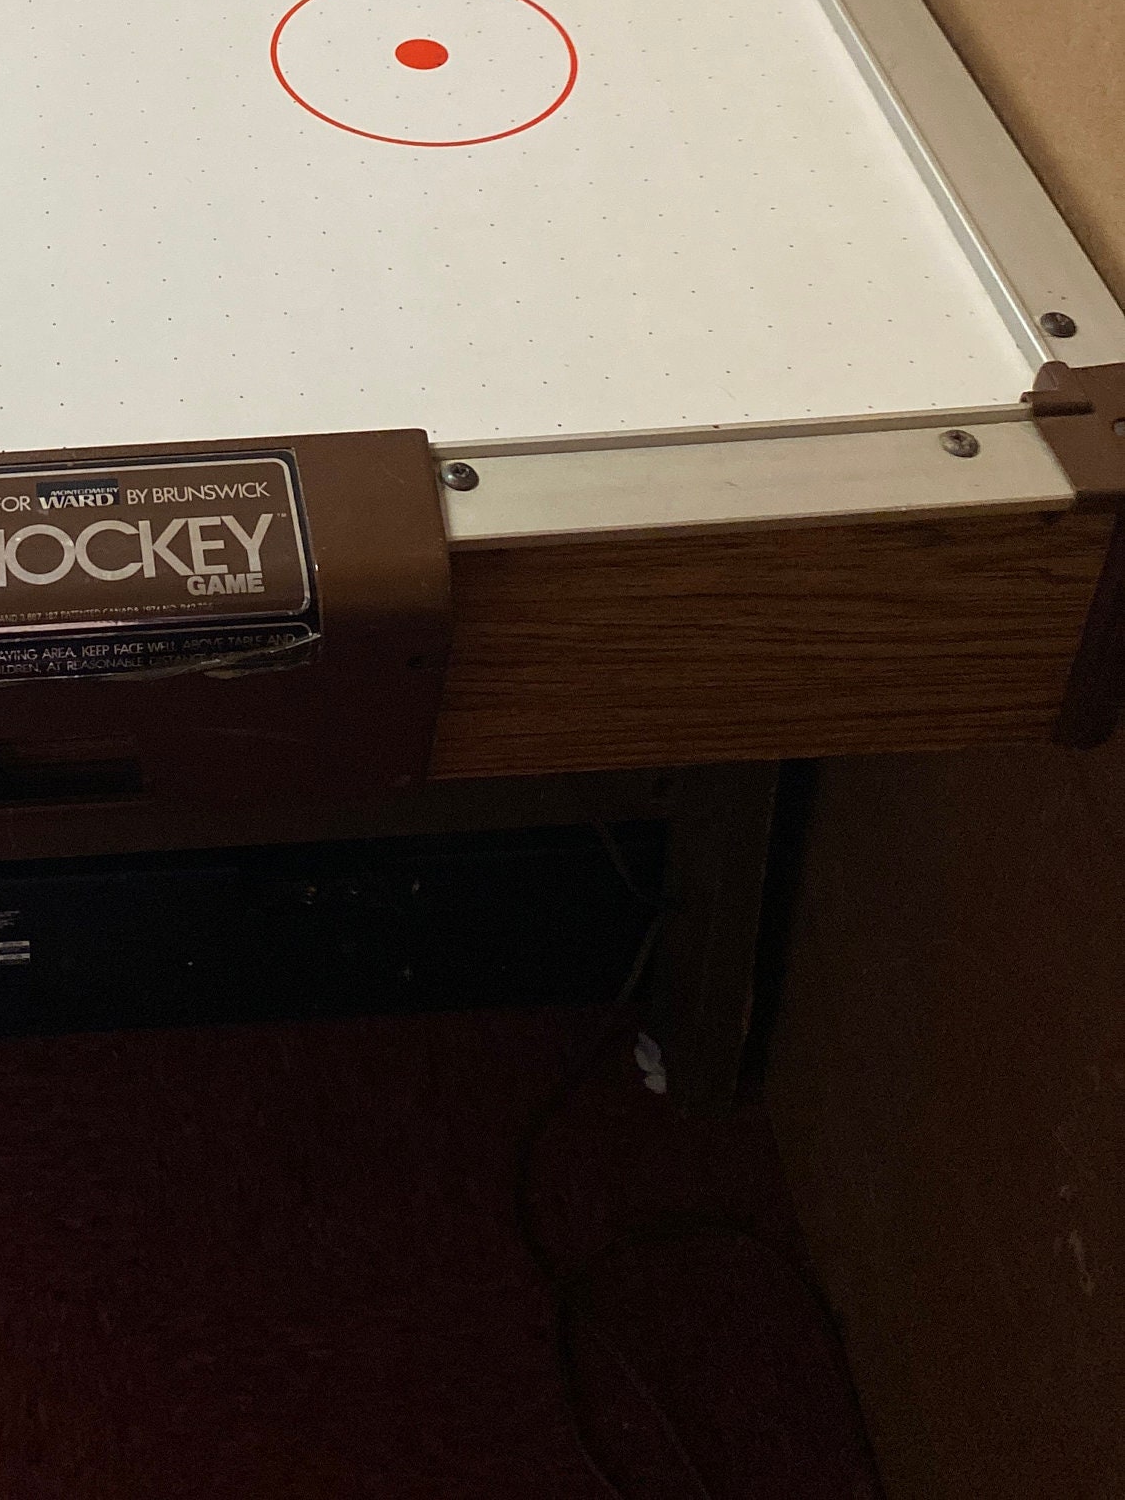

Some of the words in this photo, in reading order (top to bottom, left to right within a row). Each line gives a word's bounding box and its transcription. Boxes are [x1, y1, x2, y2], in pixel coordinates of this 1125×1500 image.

[38, 493, 114, 509] WARD
[127, 489, 148, 505] BY
[153, 481, 271, 503] BRUNSWICK
[186, 573, 265, 596] GAME
[81, 644, 109, 657] KEEP
[114, 643, 143, 655] FACE
[146, 640, 175, 652] WELL
[267, 633, 294, 646] AND
[46, 661, 62, 671] AT
[67, 656, 142, 670] REASONABLE
